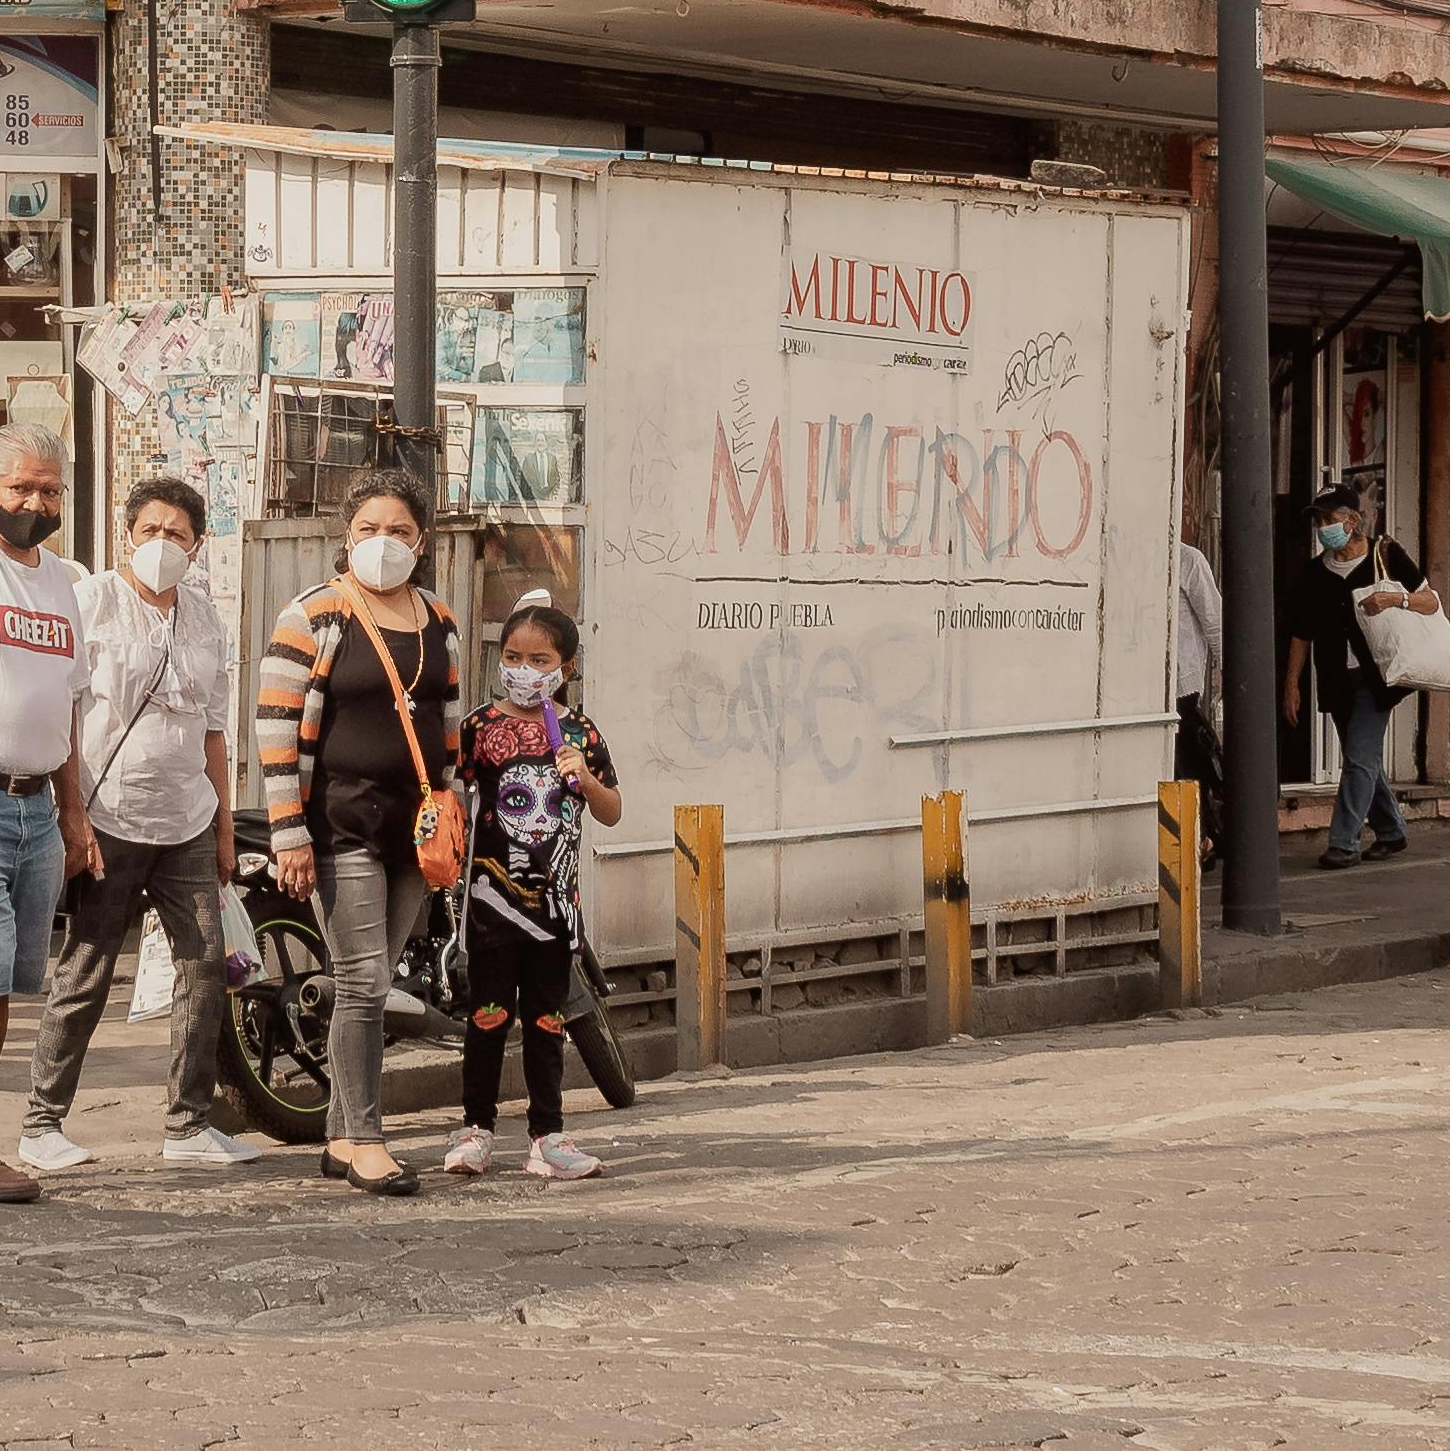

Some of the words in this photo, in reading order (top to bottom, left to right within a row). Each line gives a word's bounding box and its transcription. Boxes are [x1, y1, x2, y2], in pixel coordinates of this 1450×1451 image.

[5, 94, 30, 110] 85
[5, 112, 30, 129] 60
[38, 114, 83, 127] SERVICIOS
[5, 129, 30, 146] 48
[780, 252, 971, 337] MILENIO
[695, 602, 763, 630] DIARIO
